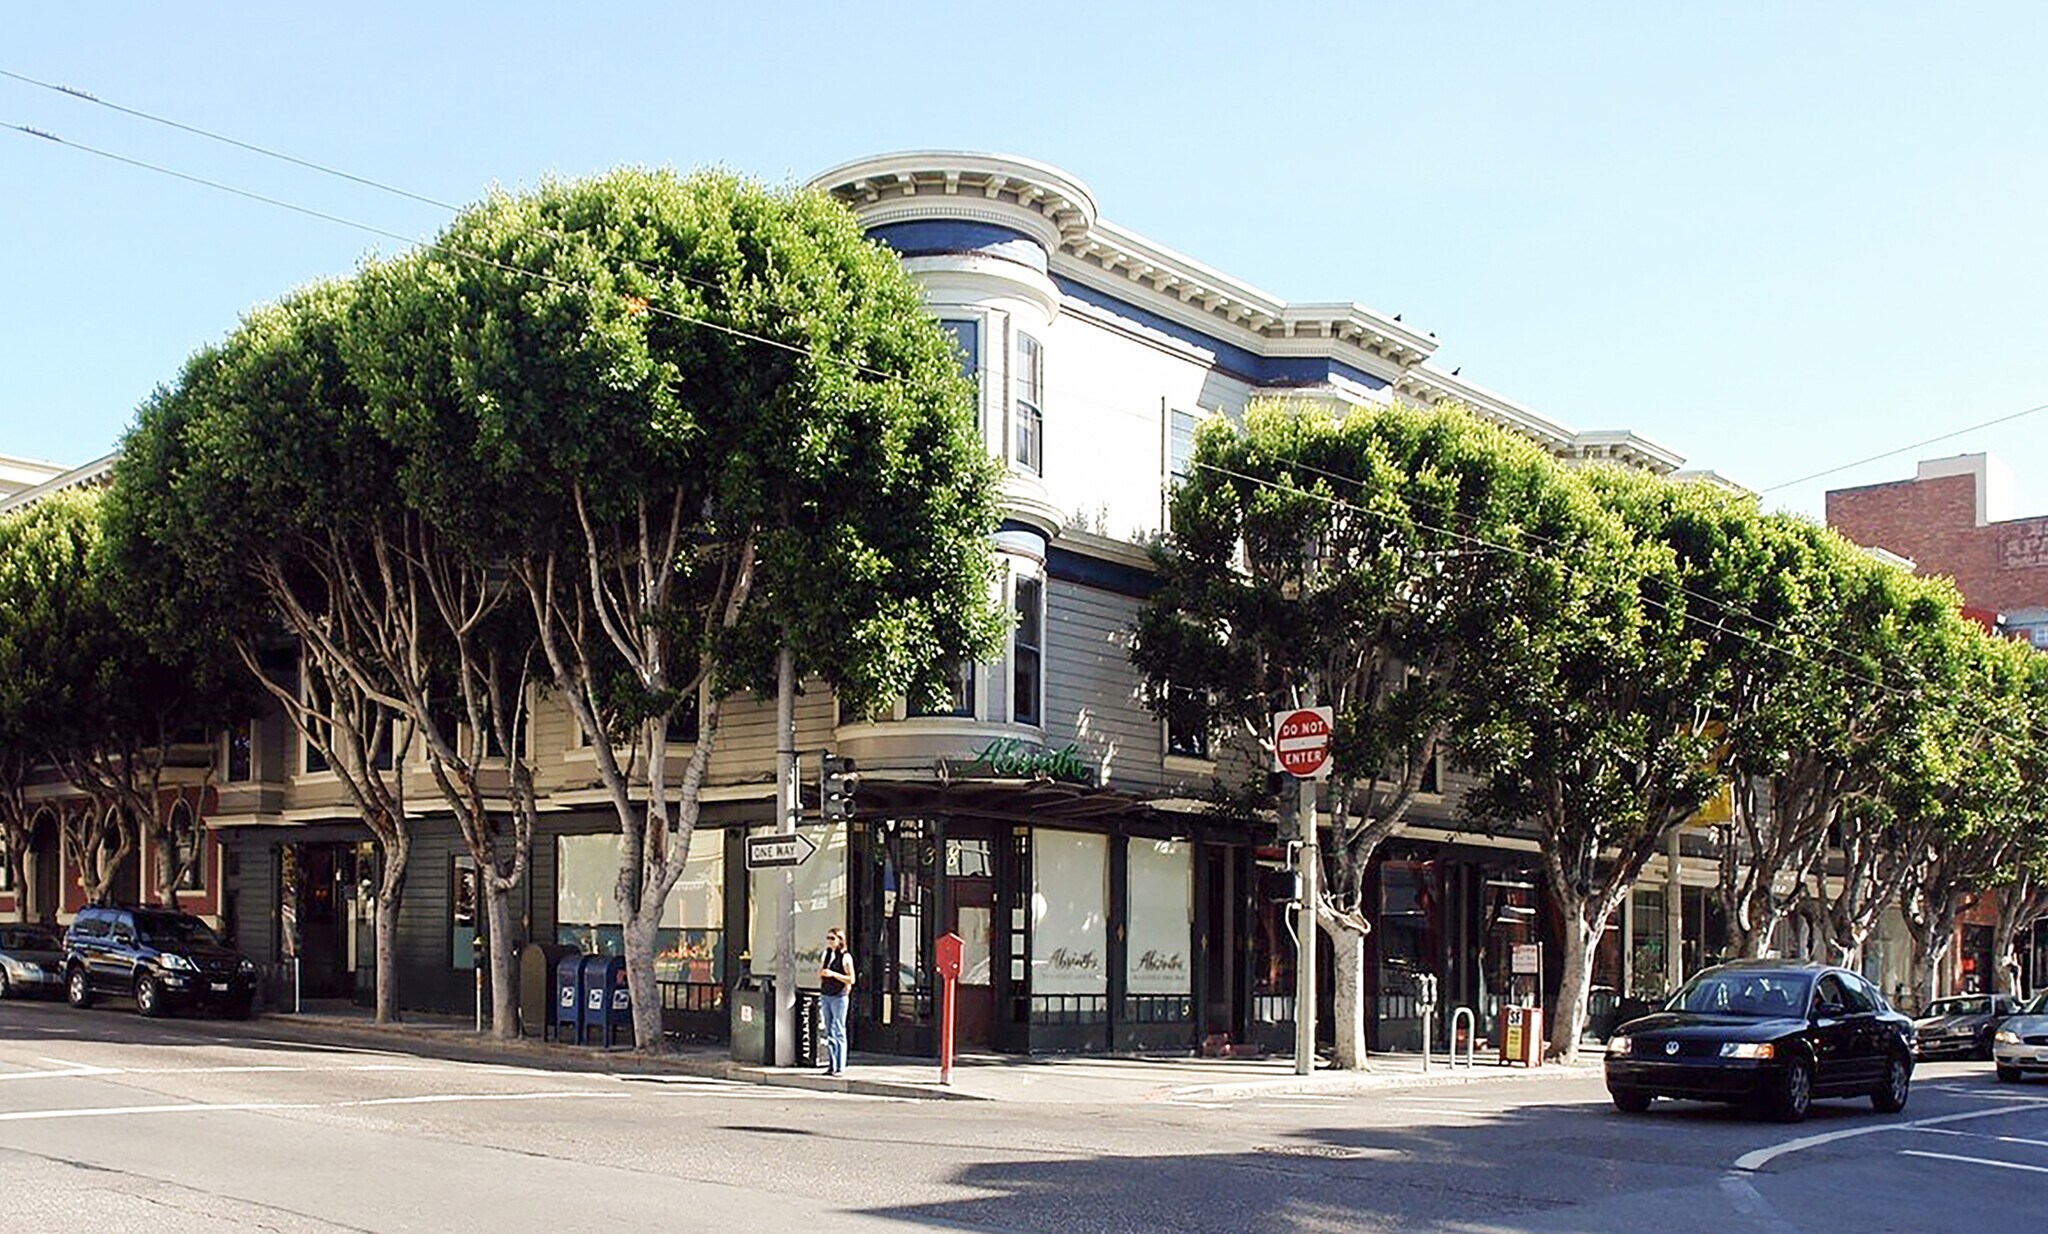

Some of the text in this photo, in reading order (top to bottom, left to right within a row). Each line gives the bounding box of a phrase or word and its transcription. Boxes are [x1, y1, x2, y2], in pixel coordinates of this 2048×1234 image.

[1282, 721, 1324, 737] DO NOT
[1285, 750, 1322, 765] ENTER
[753, 844, 796, 859] ONE WAY
